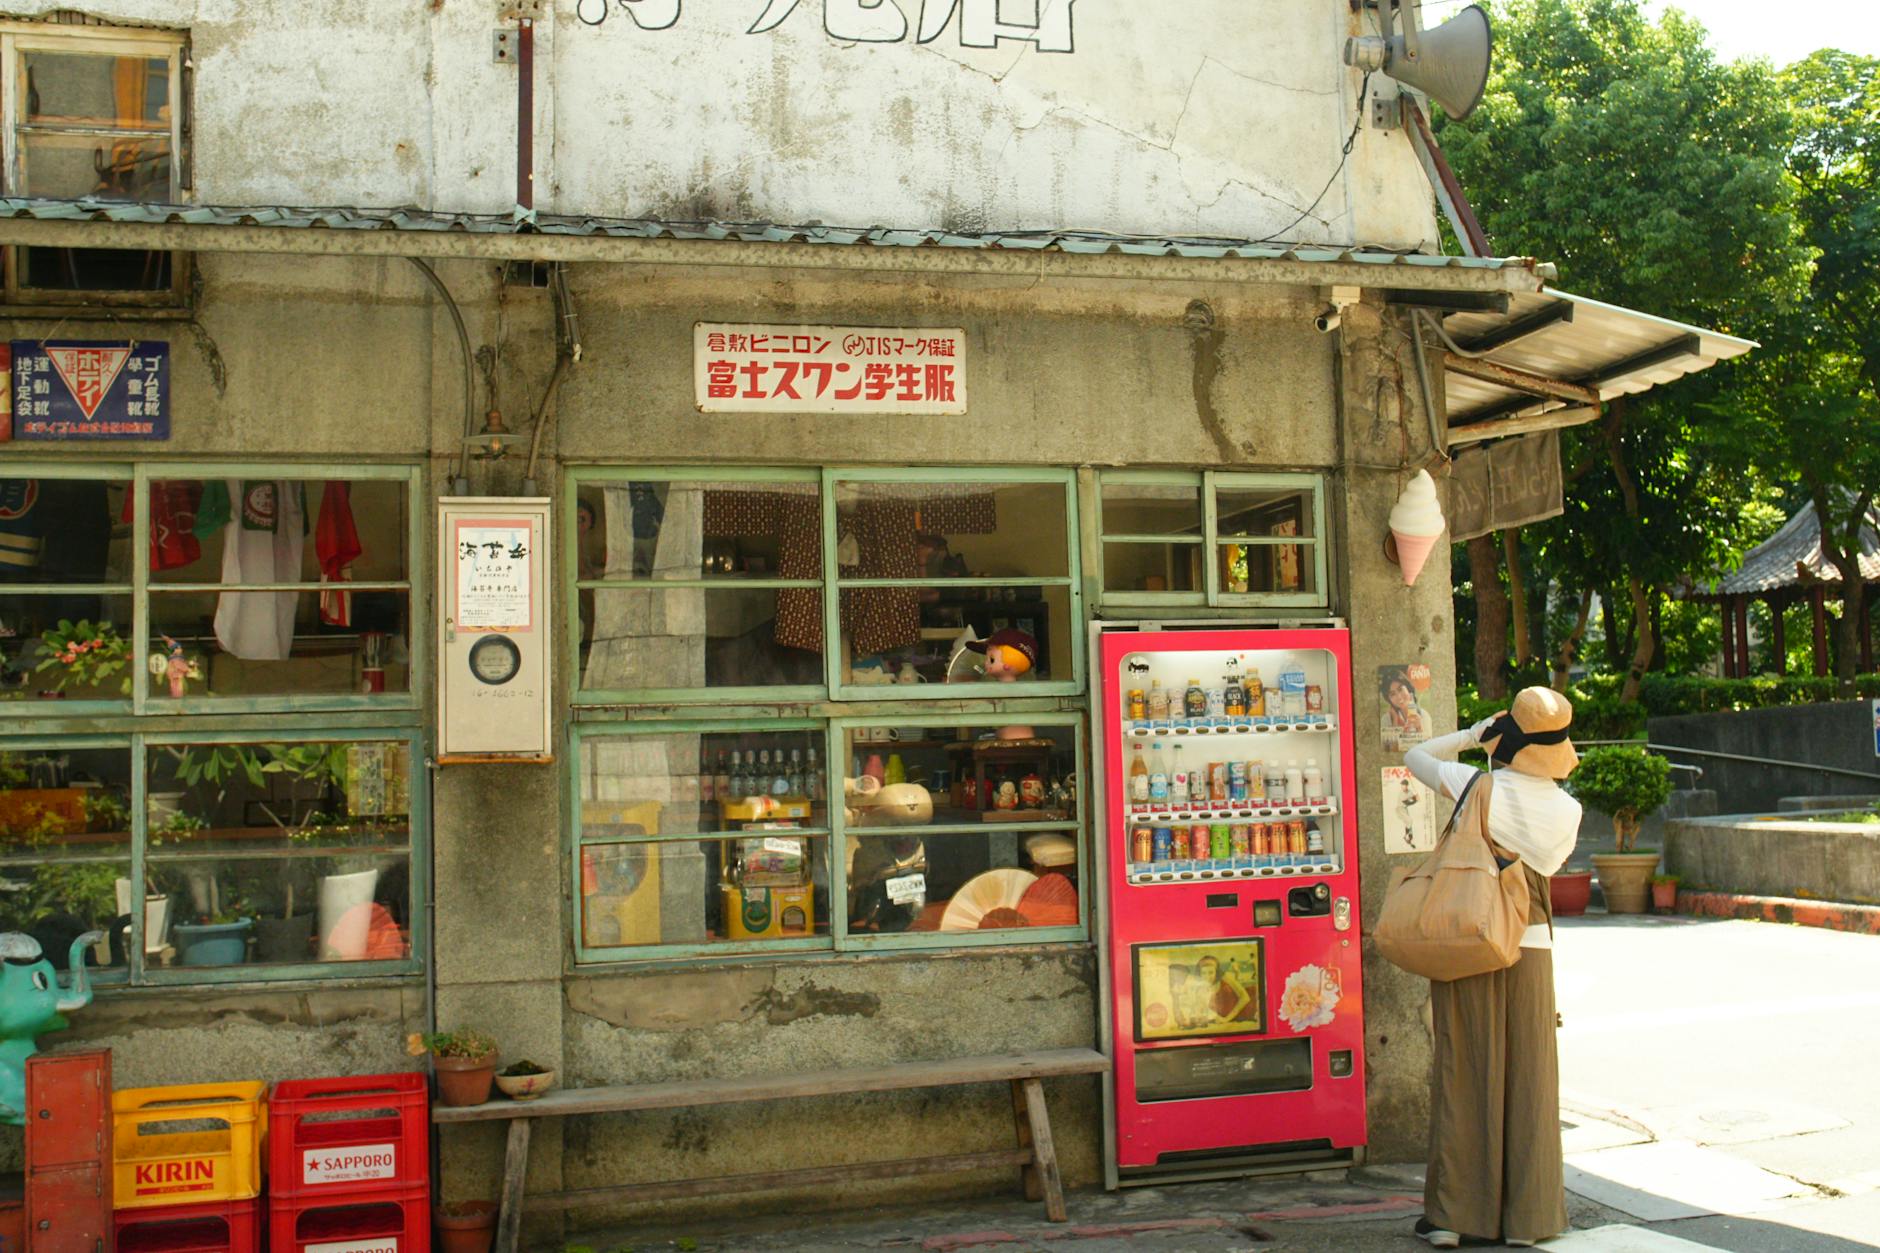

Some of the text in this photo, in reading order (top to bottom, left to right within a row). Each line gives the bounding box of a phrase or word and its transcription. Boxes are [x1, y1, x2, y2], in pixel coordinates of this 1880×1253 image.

[707, 332, 832, 354] 倉敷ビニロン
[866, 336, 955, 357] JISマーク保証
[16, 357, 32, 416] 地下足袋
[33, 356, 50, 416] 運動靴
[78, 352, 100, 408] ホテイ
[144, 355, 162, 416] ゴム長靴
[707, 359, 956, 402] 富士スワン学生服
[136, 1159, 213, 1185] KIRIN
[324, 1153, 393, 1171] SAPPORO
